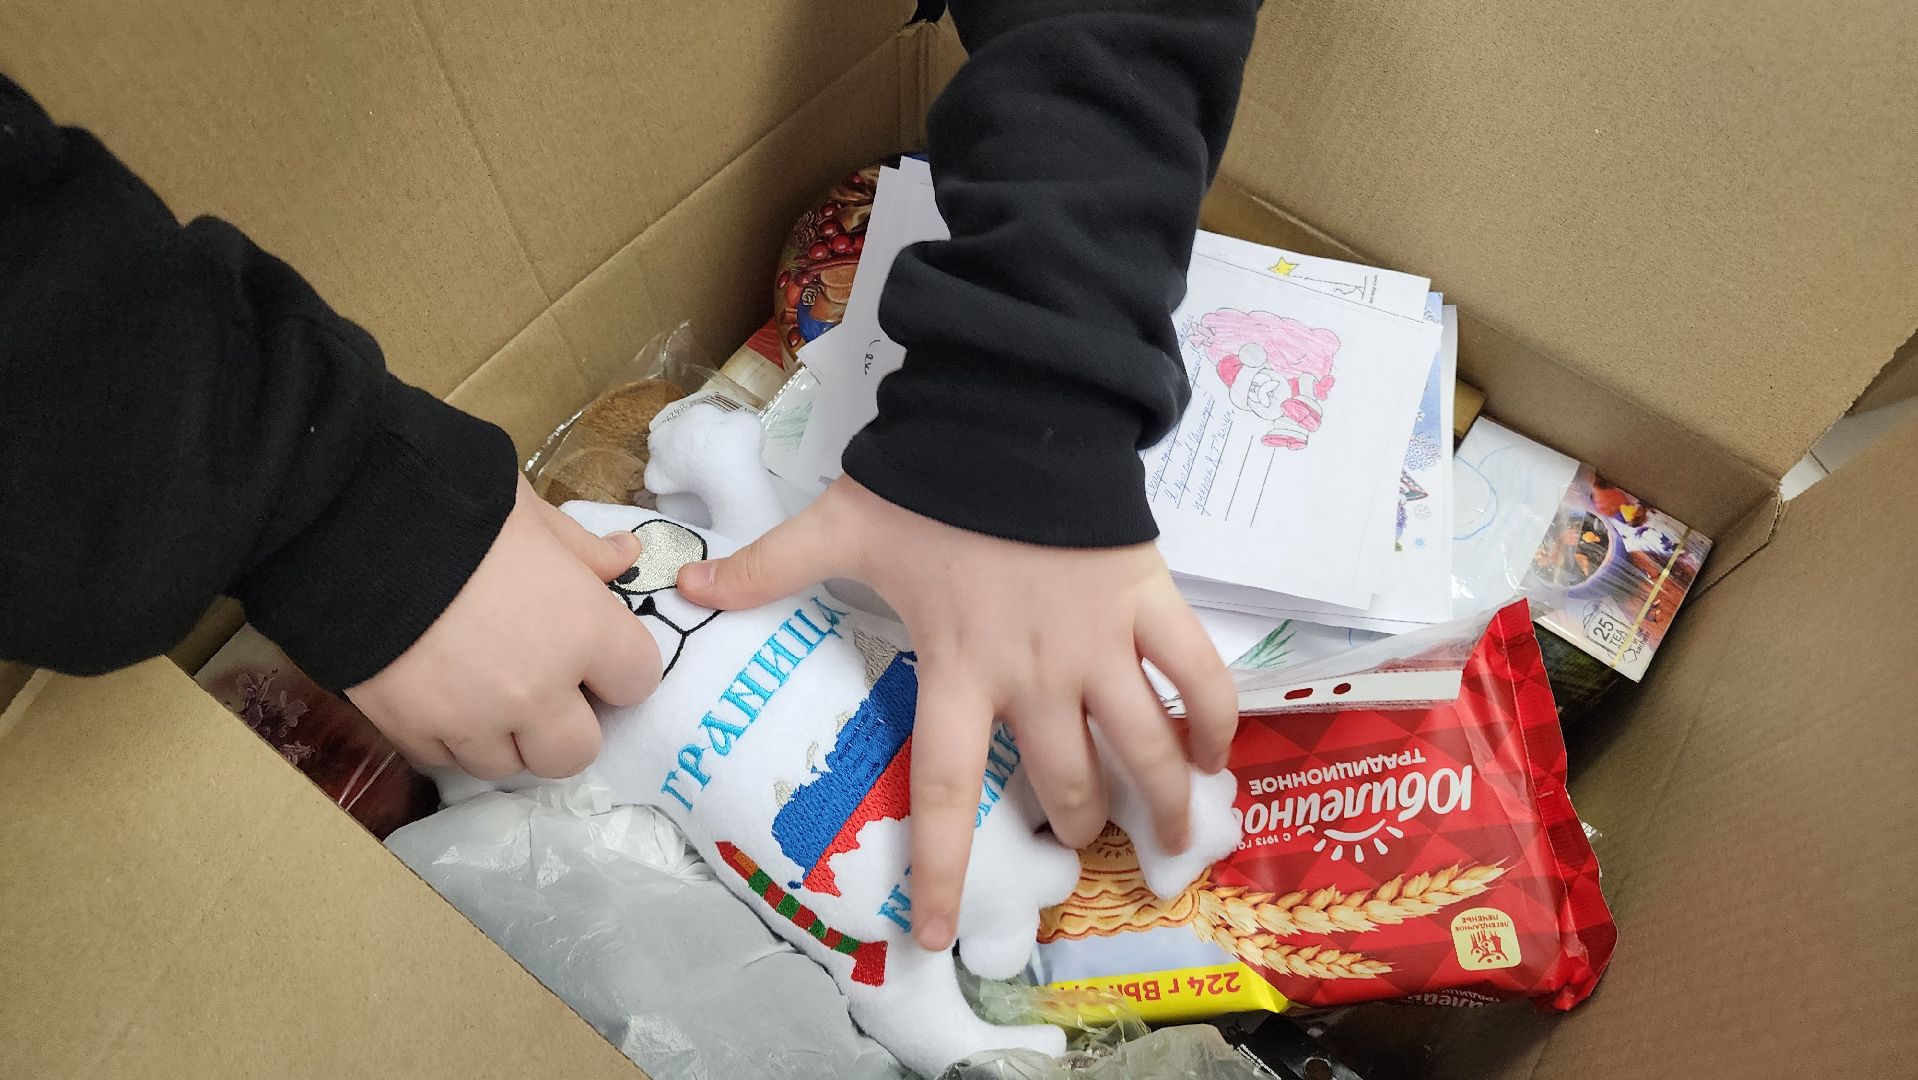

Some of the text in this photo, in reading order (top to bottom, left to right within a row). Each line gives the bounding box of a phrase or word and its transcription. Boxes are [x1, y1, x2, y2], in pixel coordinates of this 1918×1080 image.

[1593, 617, 1614, 641] 25
[1609, 629, 1625, 646] TEA
[660, 596, 849, 812] ГРАНИЦА
[1249, 748, 1427, 796] ТРАДИЦИОННОЕ
[1255, 835, 1279, 846] 1913
[1455, 921, 1509, 932] ЛЕГЕНДАРНОЕ
[1461, 914, 1499, 923] ПЕЧЕНЬЕ
[1186, 971, 1241, 997] 224
